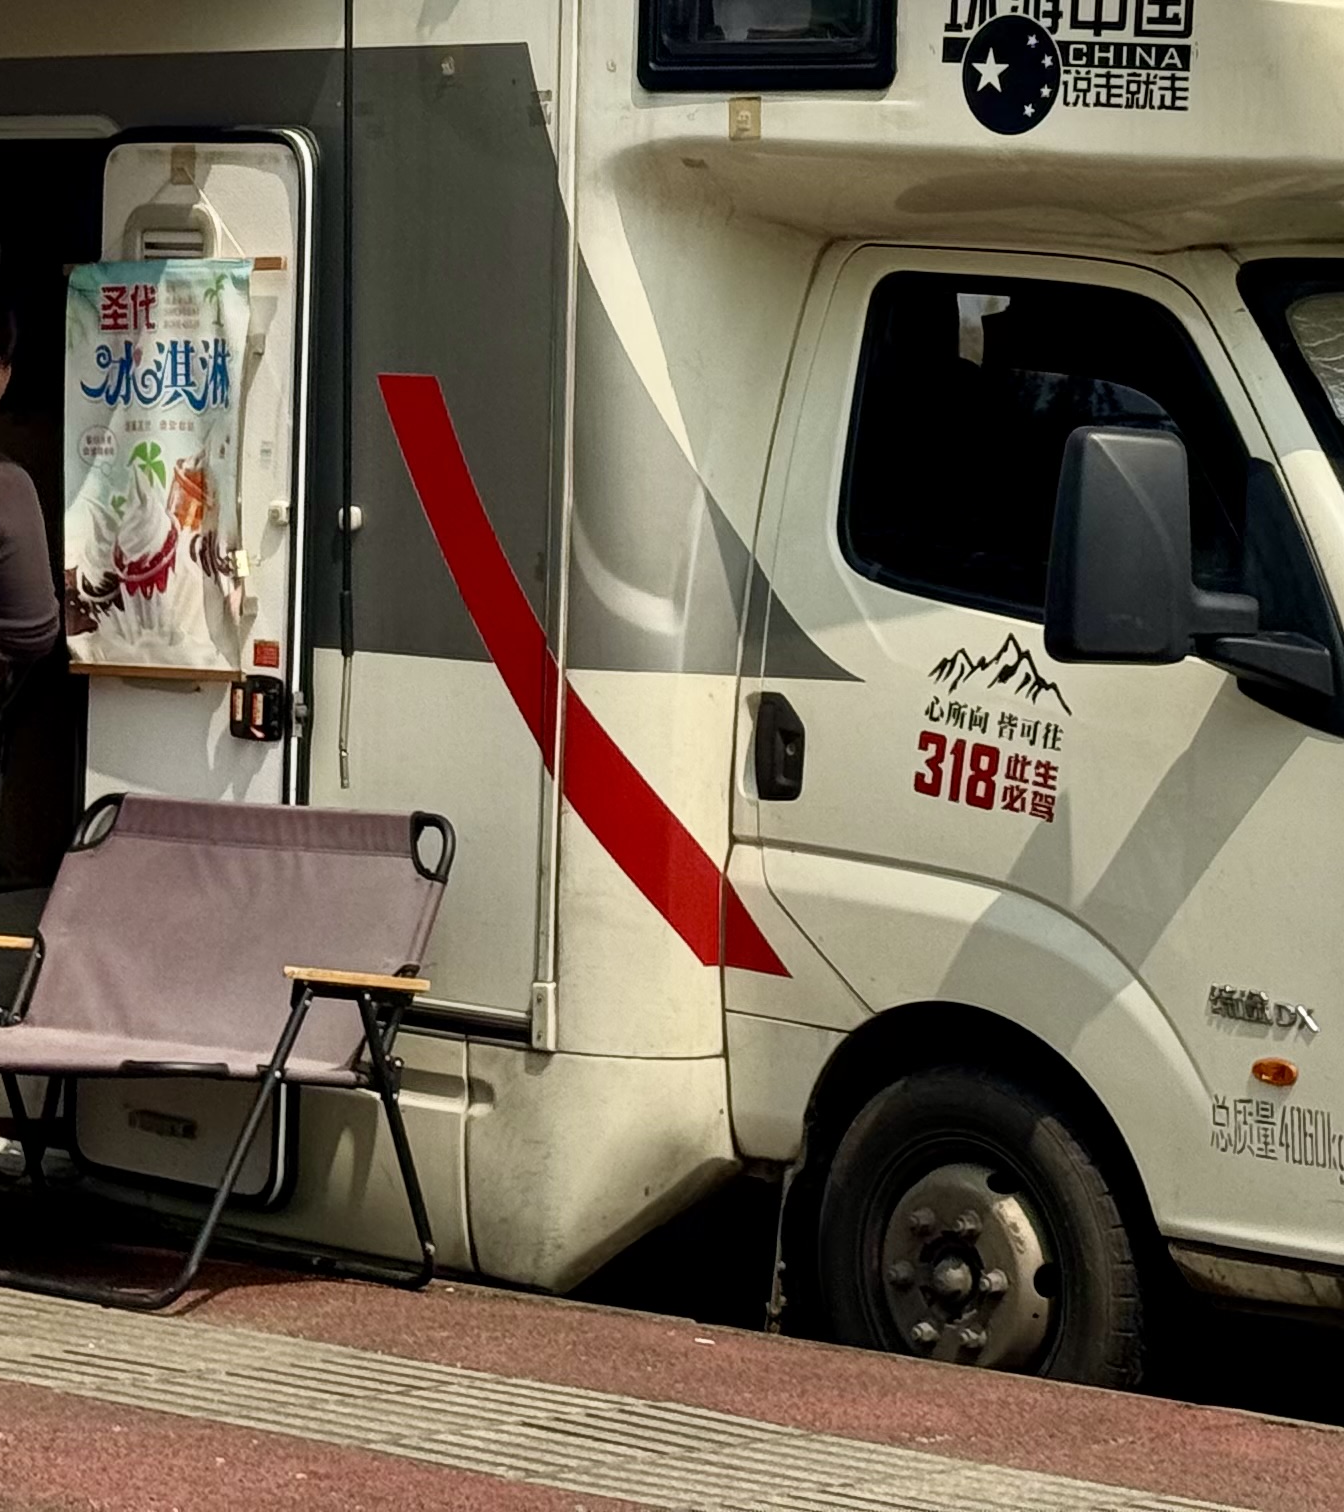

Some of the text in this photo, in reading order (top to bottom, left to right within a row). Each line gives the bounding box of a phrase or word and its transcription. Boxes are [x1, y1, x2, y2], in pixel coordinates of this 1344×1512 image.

[1068, 43, 1184, 70] CHINA
[1061, 69, 1190, 111] 说走就走
[100, 284, 157, 331] 圣代
[80, 337, 231, 409] 冰淇淋
[924, 695, 1064, 752] 心所向 皆可往
[913, 730, 1000, 811] 318
[1004, 753, 1059, 790] 此生
[1001, 784, 1056, 823] 必驾
